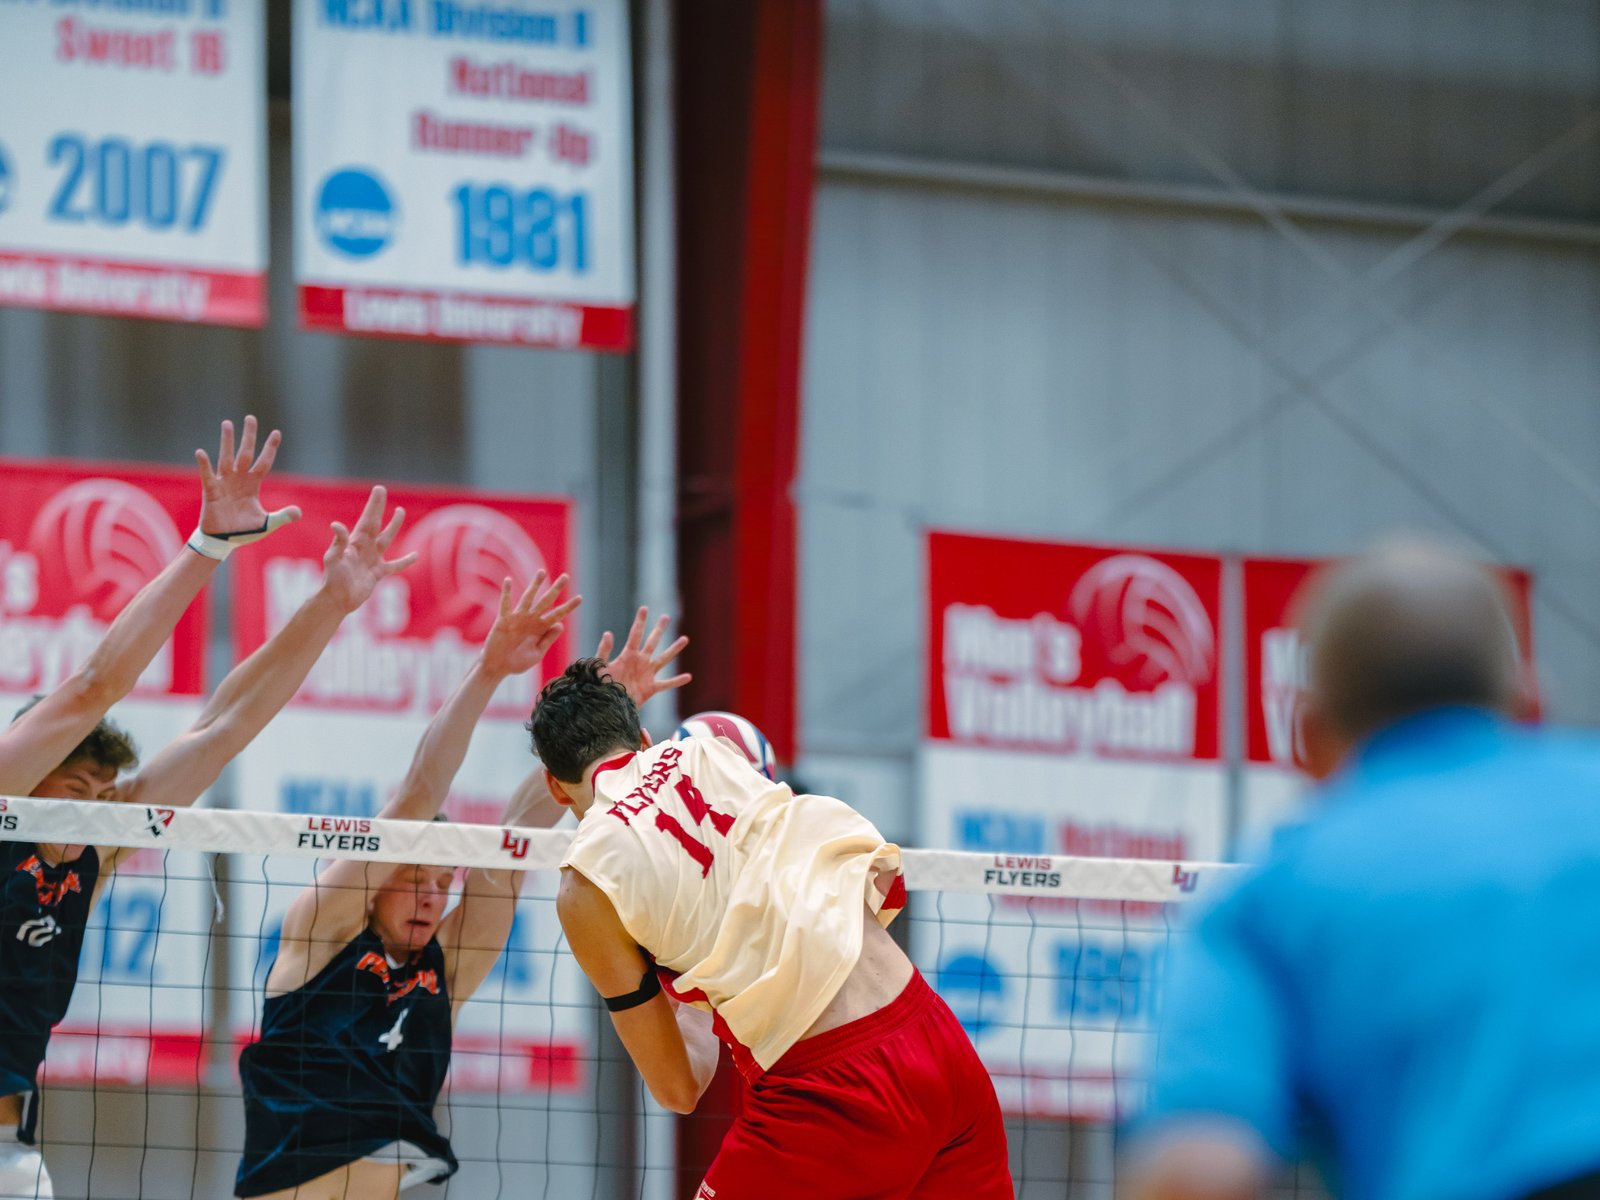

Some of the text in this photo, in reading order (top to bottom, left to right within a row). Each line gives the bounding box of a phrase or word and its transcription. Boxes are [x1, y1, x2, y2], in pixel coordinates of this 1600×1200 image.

[49, 135, 224, 233] 2007
[943, 603, 1081, 680] Men's
[945, 678, 1196, 760] Volleyball
[606, 747, 682, 826] FLYERS
[297, 832, 380, 851] FLYERS
[308, 816, 371, 833] LEWIS
[501, 829, 530, 860] LU
[655, 774, 736, 879] 14
[983, 869, 1061, 888] FLYERS
[994, 855, 1052, 871] LEWIS
[378, 1008, 409, 1053] 4
